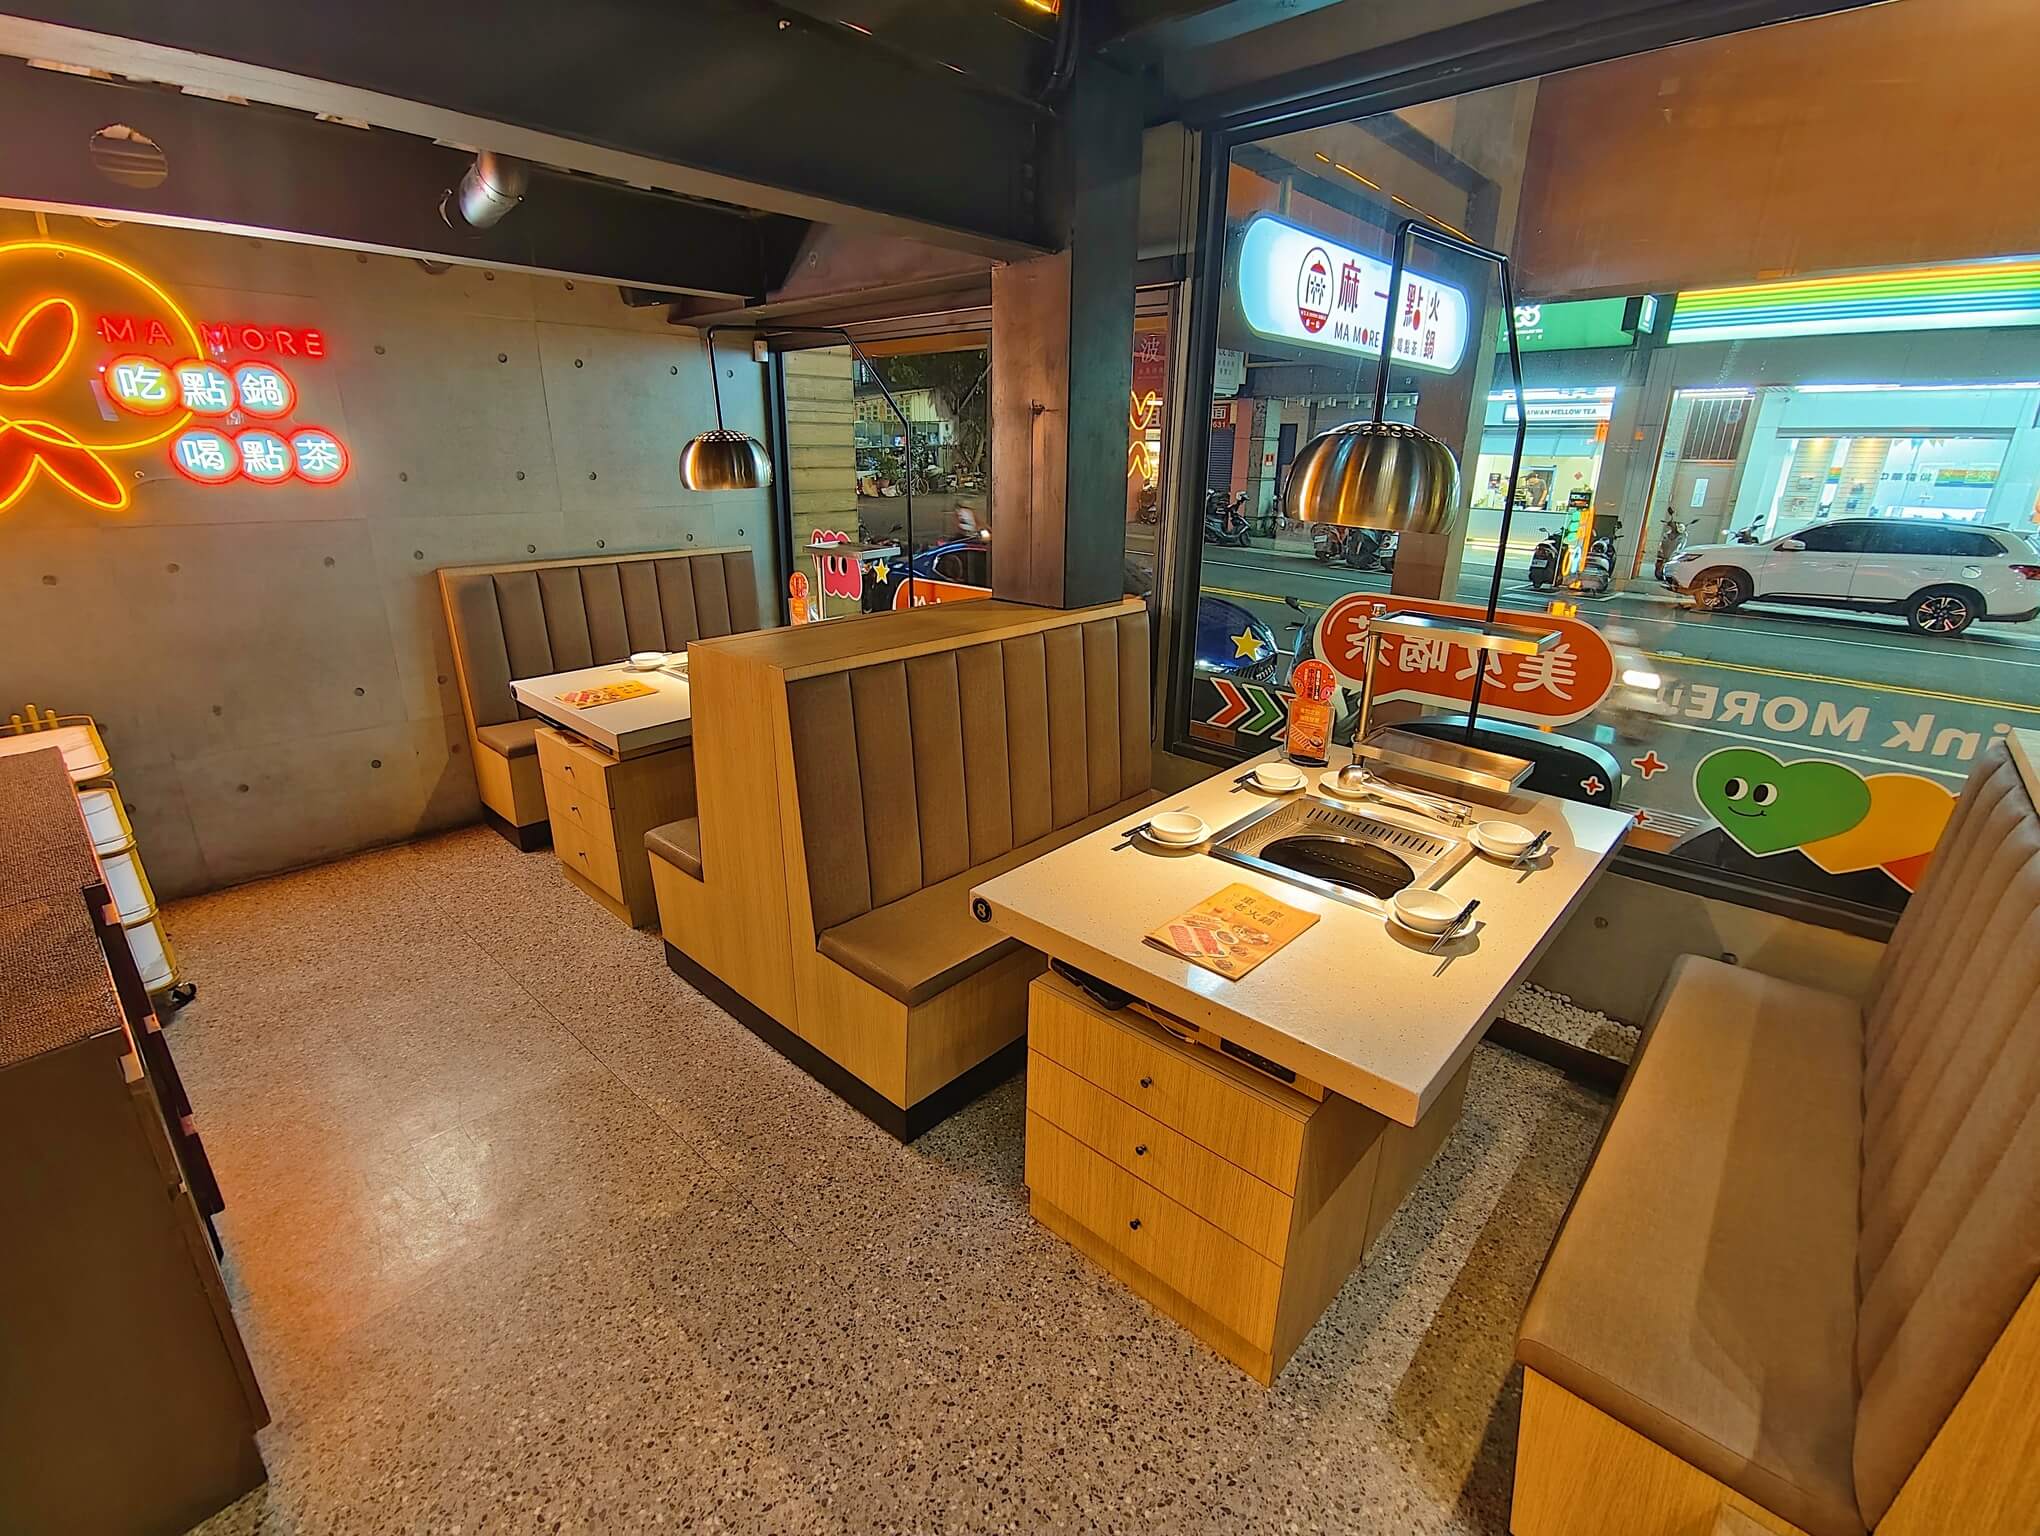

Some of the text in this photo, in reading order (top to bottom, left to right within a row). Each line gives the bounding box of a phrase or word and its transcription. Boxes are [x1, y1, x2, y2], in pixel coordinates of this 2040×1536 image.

[99, 317, 325, 356] MA MORE
[1334, 322, 1349, 343] MA
[116, 366, 283, 407] 吃點鍋
[181, 439, 340, 473] 喝點茶
